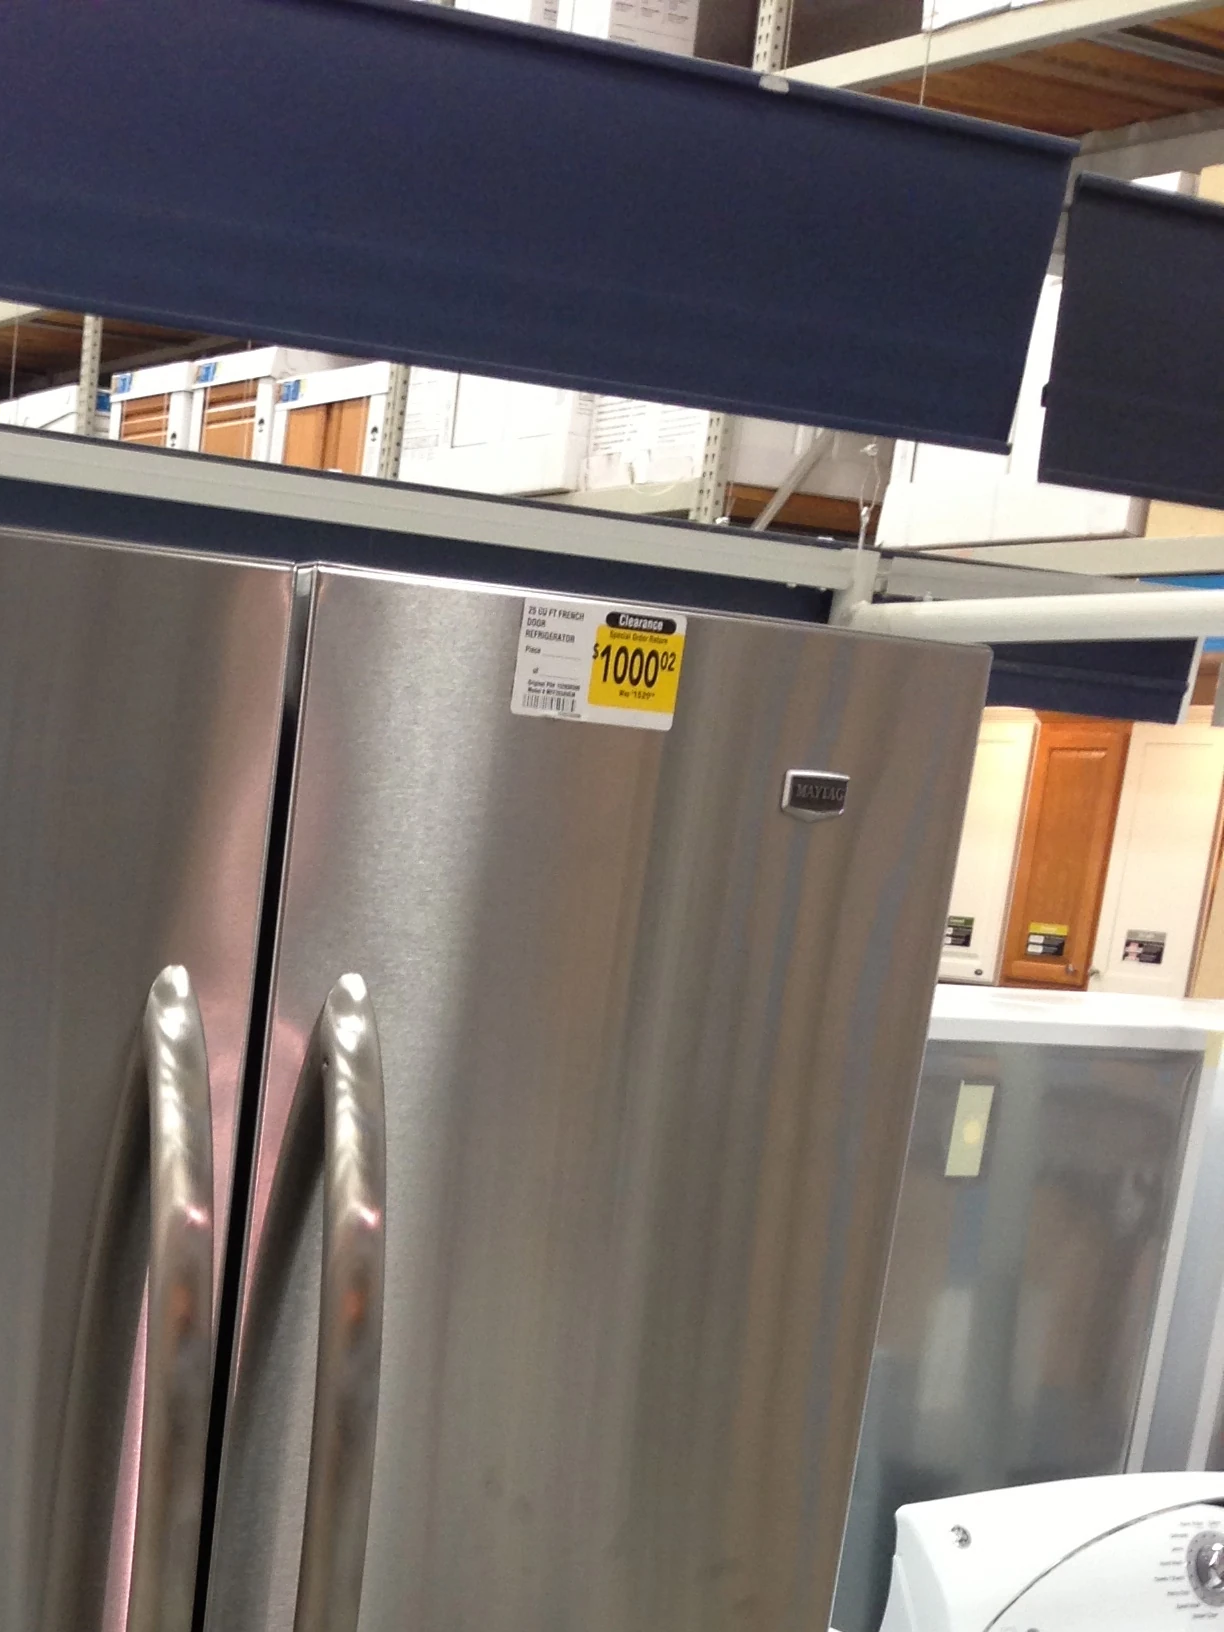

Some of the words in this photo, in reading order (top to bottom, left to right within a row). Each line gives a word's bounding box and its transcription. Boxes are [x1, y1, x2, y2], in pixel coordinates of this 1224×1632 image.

[558, 609, 585, 621] FRENCH
[527, 618, 546, 627] DOOR
[618, 613, 664, 631] Clearance
[525, 629, 575, 643] REFRIGERATOR
[609, 630, 631, 639] Special
[632, 633, 649, 642] Order
[796, 783, 845, 801] MAYTAG
